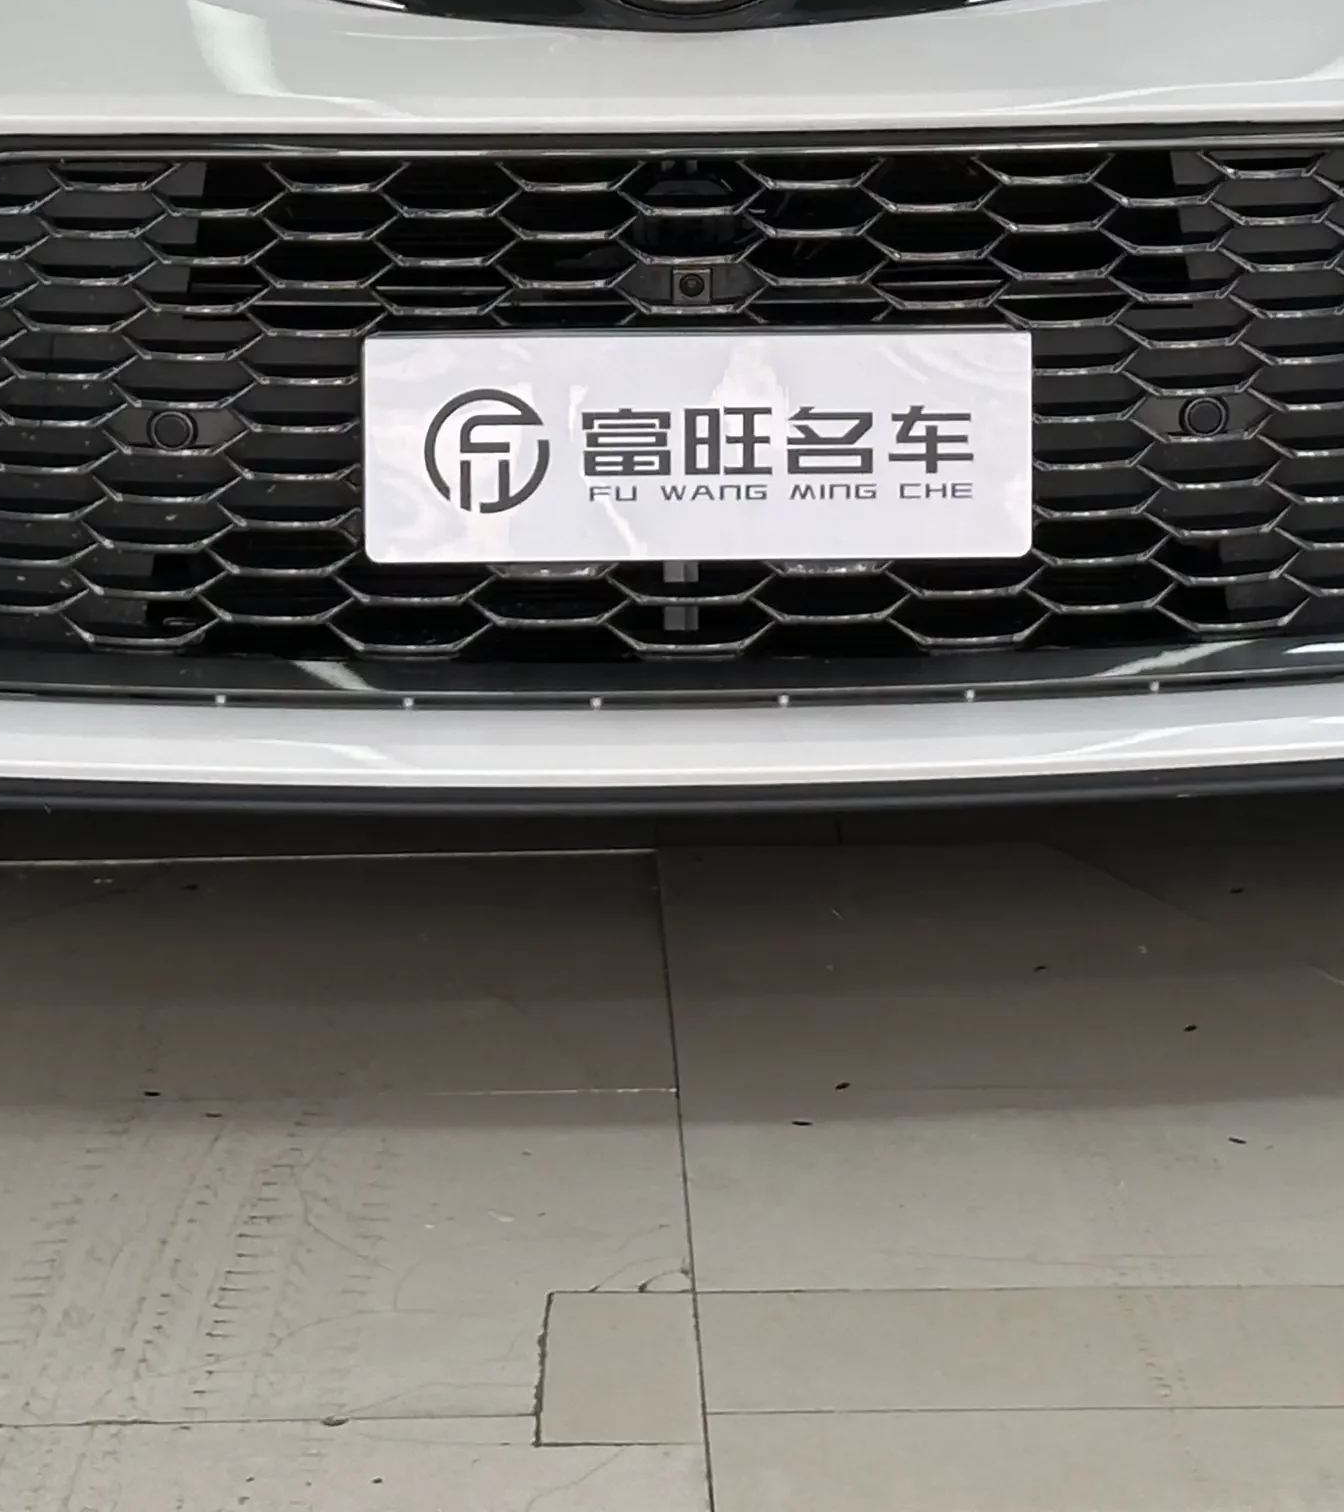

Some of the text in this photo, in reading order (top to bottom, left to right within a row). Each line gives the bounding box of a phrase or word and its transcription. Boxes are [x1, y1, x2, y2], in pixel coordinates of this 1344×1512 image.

[581, 403, 975, 477] 富旺名车
[589, 482, 975, 503] FU WANG MING CHE
